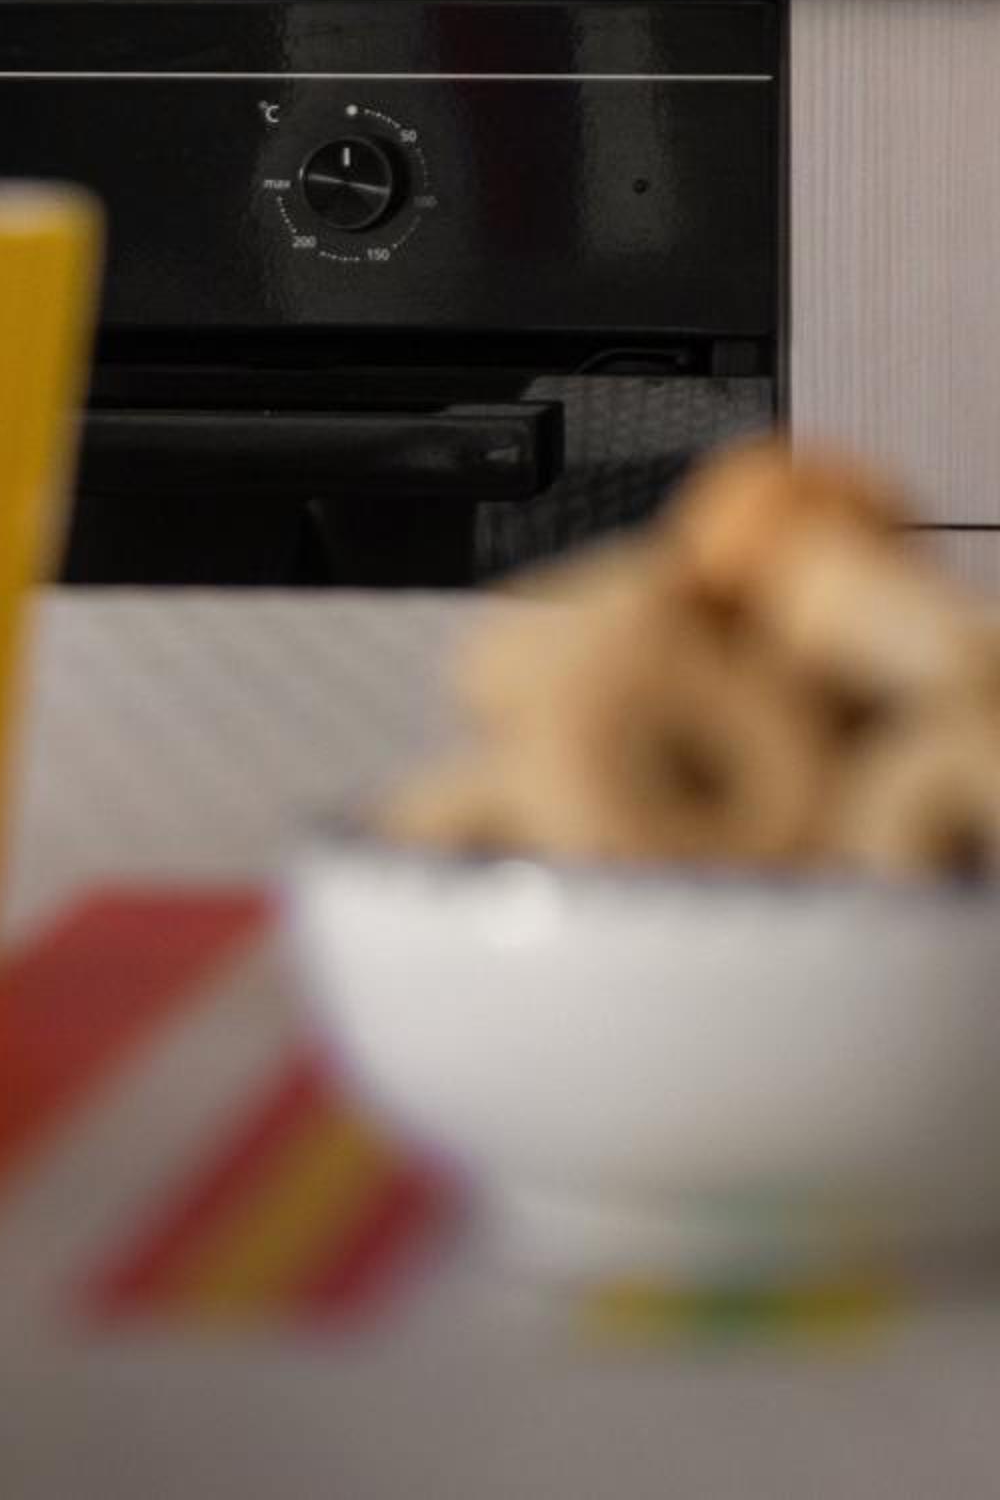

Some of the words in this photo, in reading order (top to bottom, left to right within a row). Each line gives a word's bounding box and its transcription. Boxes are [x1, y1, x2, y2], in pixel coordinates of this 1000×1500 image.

[401, 129, 418, 143] 50
[292, 235, 317, 248] 200
[367, 248, 391, 261] 150
